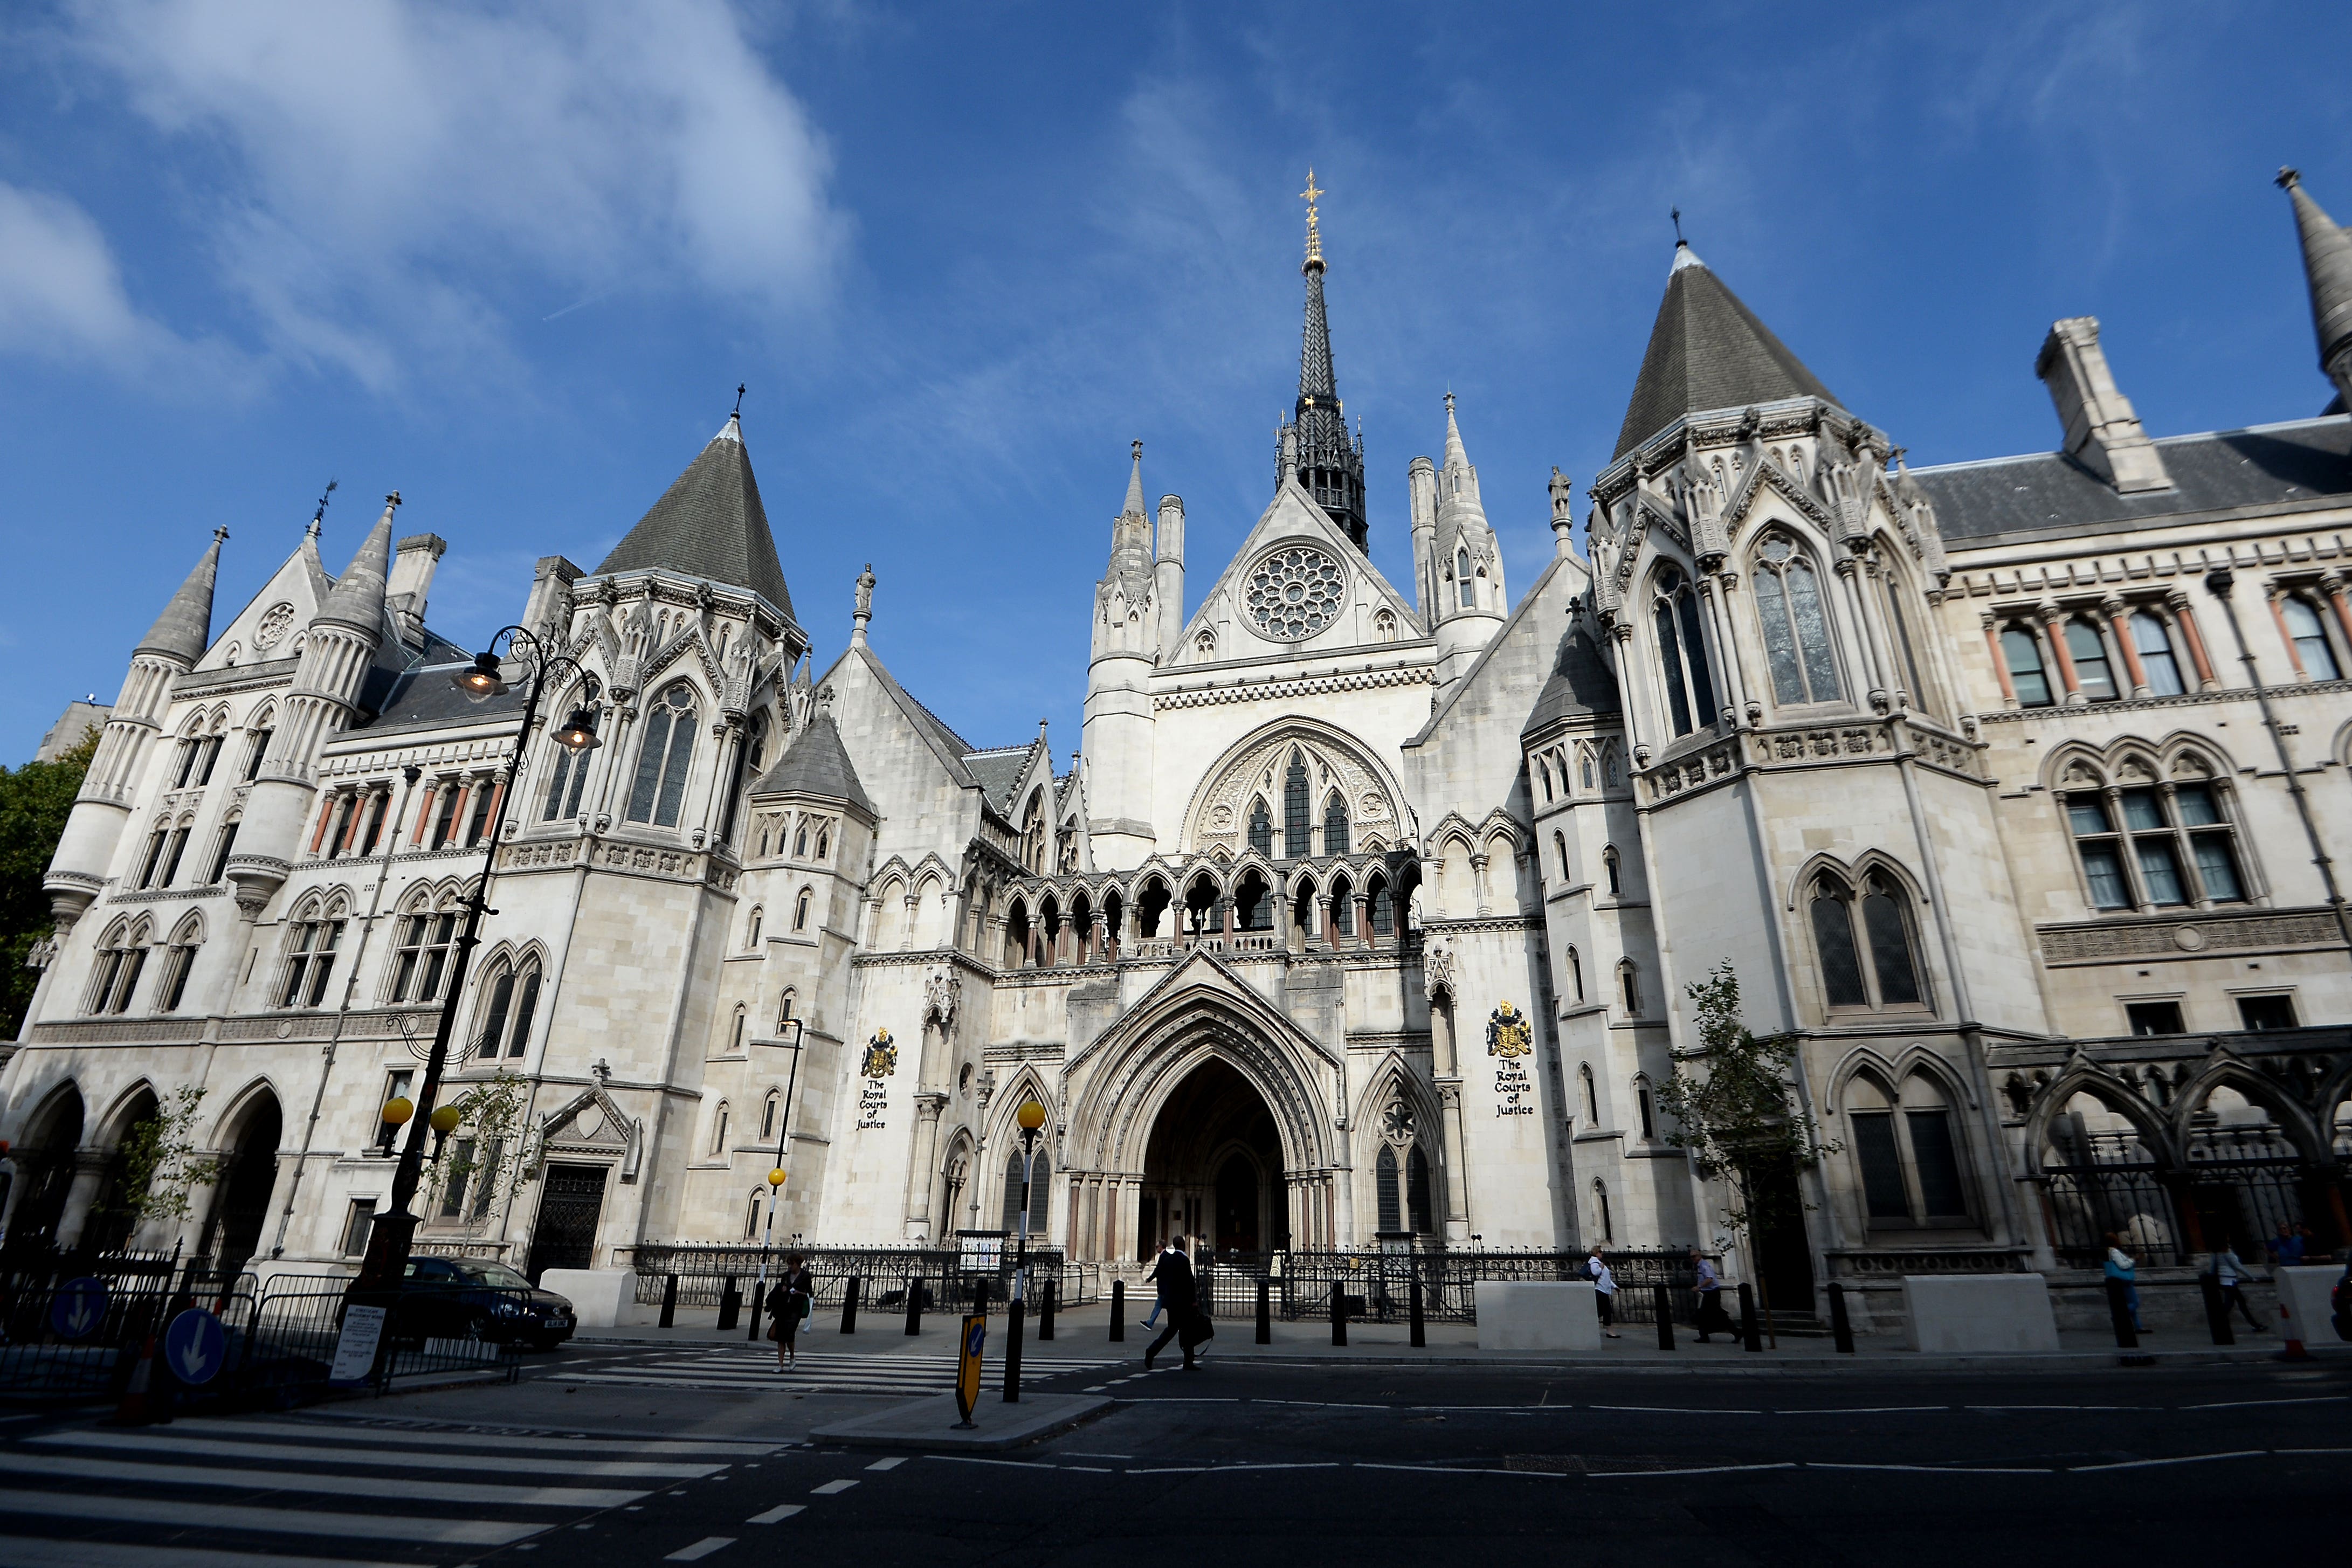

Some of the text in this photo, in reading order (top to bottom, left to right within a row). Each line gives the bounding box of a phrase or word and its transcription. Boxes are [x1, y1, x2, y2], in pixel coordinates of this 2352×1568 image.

[1499, 1059, 1520, 1070] The
[1496, 1069, 1527, 1083] Royal
[868, 1080, 884, 1089] The
[1495, 1082, 1530, 1093] Courts
[863, 1089, 886, 1101] Royal
[1507, 1093, 1520, 1103] of
[859, 1100, 887, 1109] Courts
[867, 1109, 877, 1118] of
[1496, 1104, 1533, 1118] Justice
[856, 1119, 885, 1131] Justice
